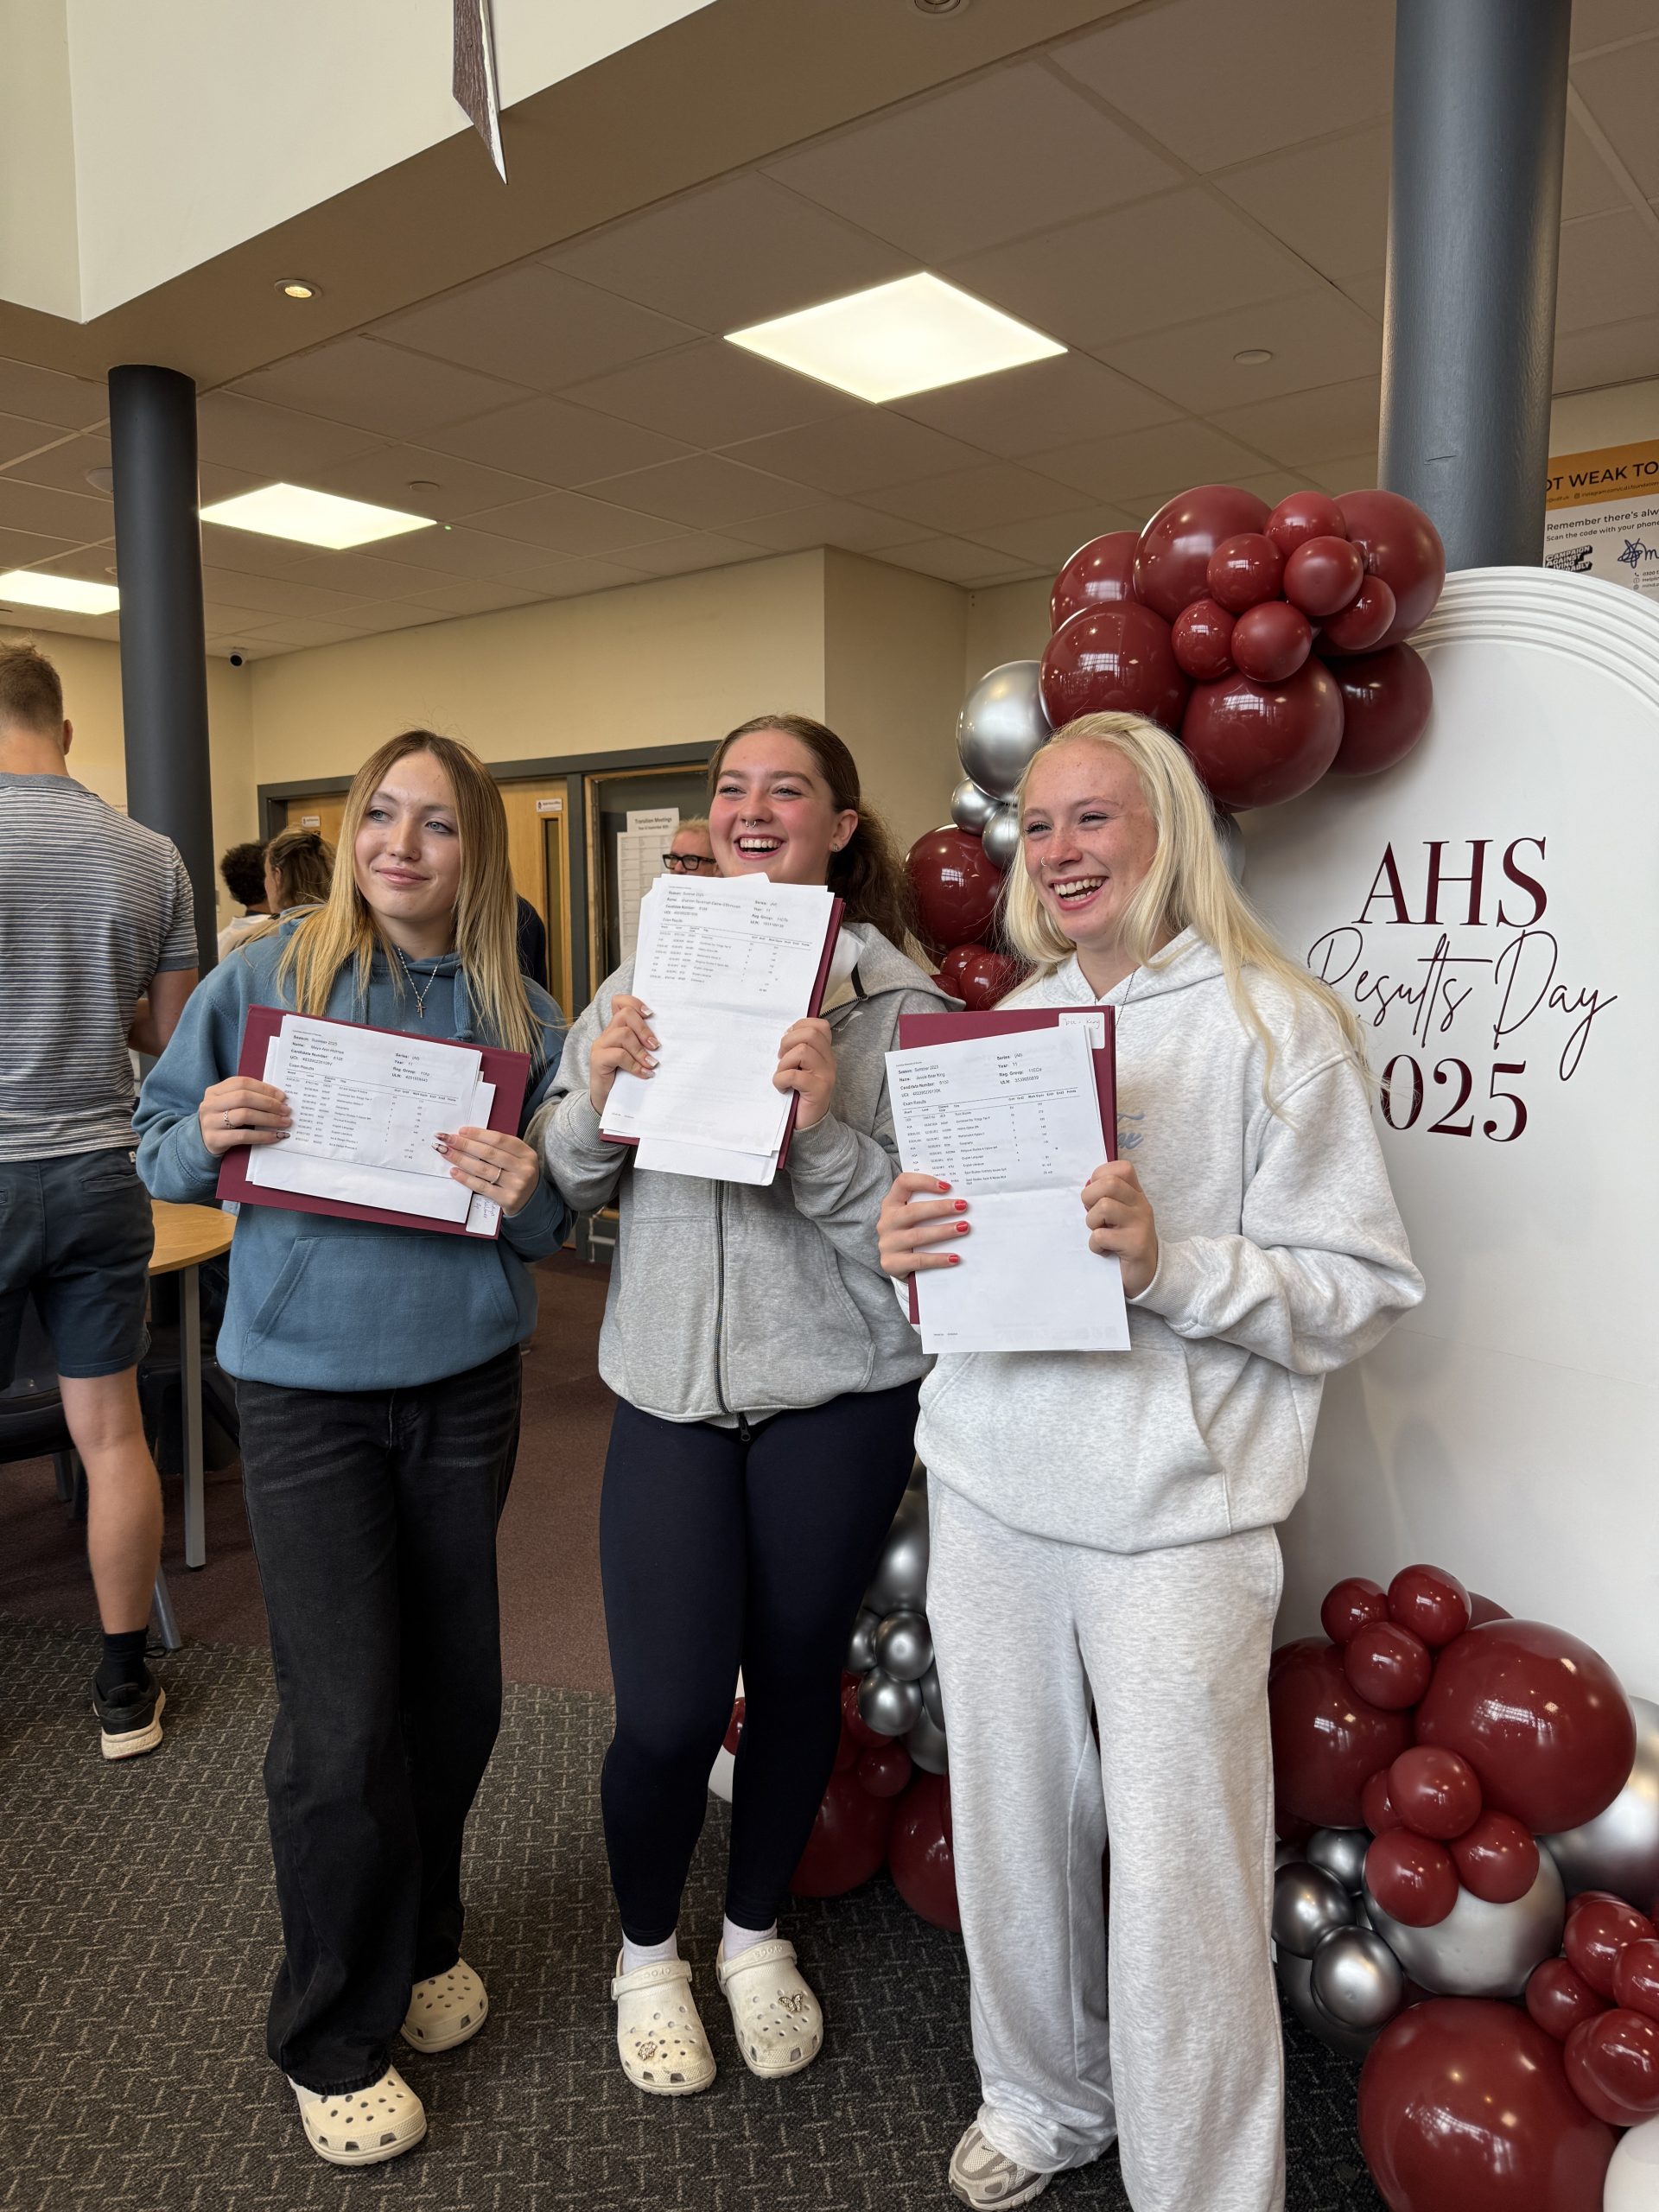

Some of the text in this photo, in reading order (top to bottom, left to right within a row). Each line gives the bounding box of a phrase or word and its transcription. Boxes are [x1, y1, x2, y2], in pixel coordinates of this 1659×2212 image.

[1547, 461, 1659, 492] OT WEAK TO
[1547, 518, 1601, 531] Remember
[1604, 512, 1638, 523] there's
[1547, 533, 1564, 542] Scan
[1546, 554, 1582, 567] AGAINST
[1553, 560, 1575, 569] IVING
[1351, 836, 1548, 928] AHS
[1494, 929, 1618, 1082] Day
[1380, 1054, 1528, 1142] 025
